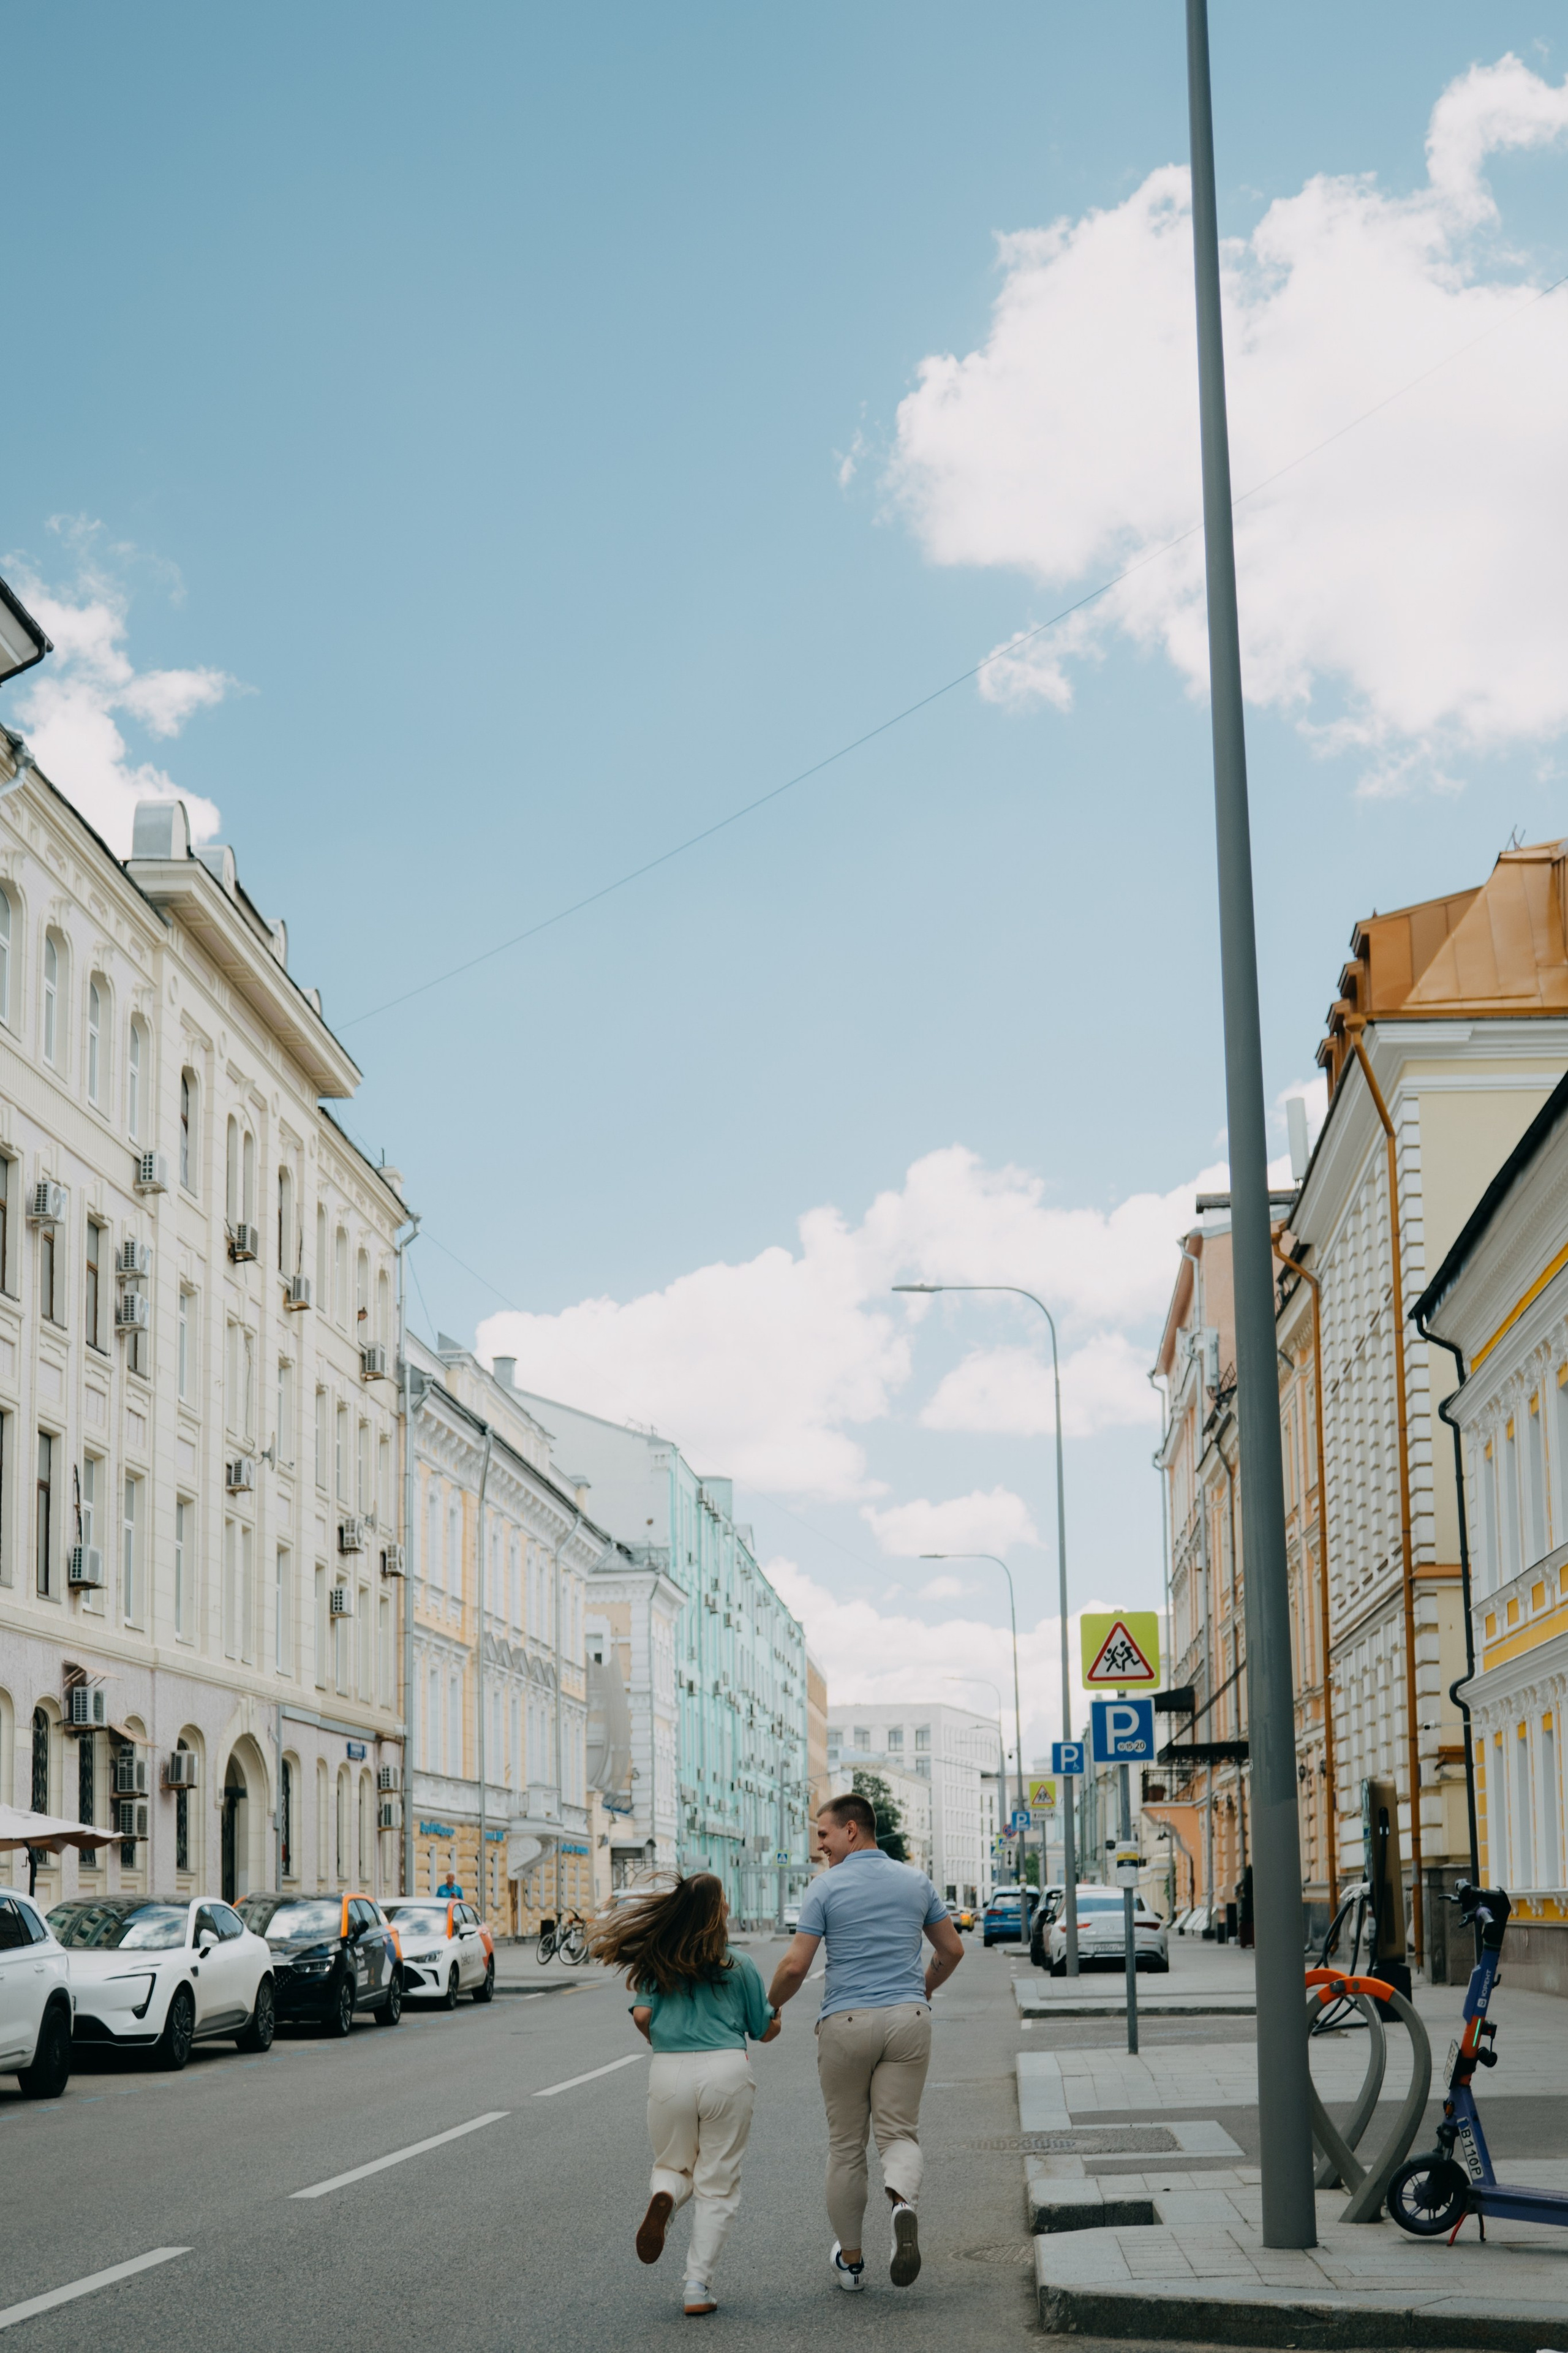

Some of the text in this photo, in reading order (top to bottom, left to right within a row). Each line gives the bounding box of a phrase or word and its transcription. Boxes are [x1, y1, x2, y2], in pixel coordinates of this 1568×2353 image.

[1105, 1705, 1140, 1755] P
[1060, 1744, 1079, 1772] P
[1135, 1741, 1145, 1750] 20
[1016, 1813, 1027, 1830] P
[1481, 1968, 1491, 1997] ЮРЕНТ
